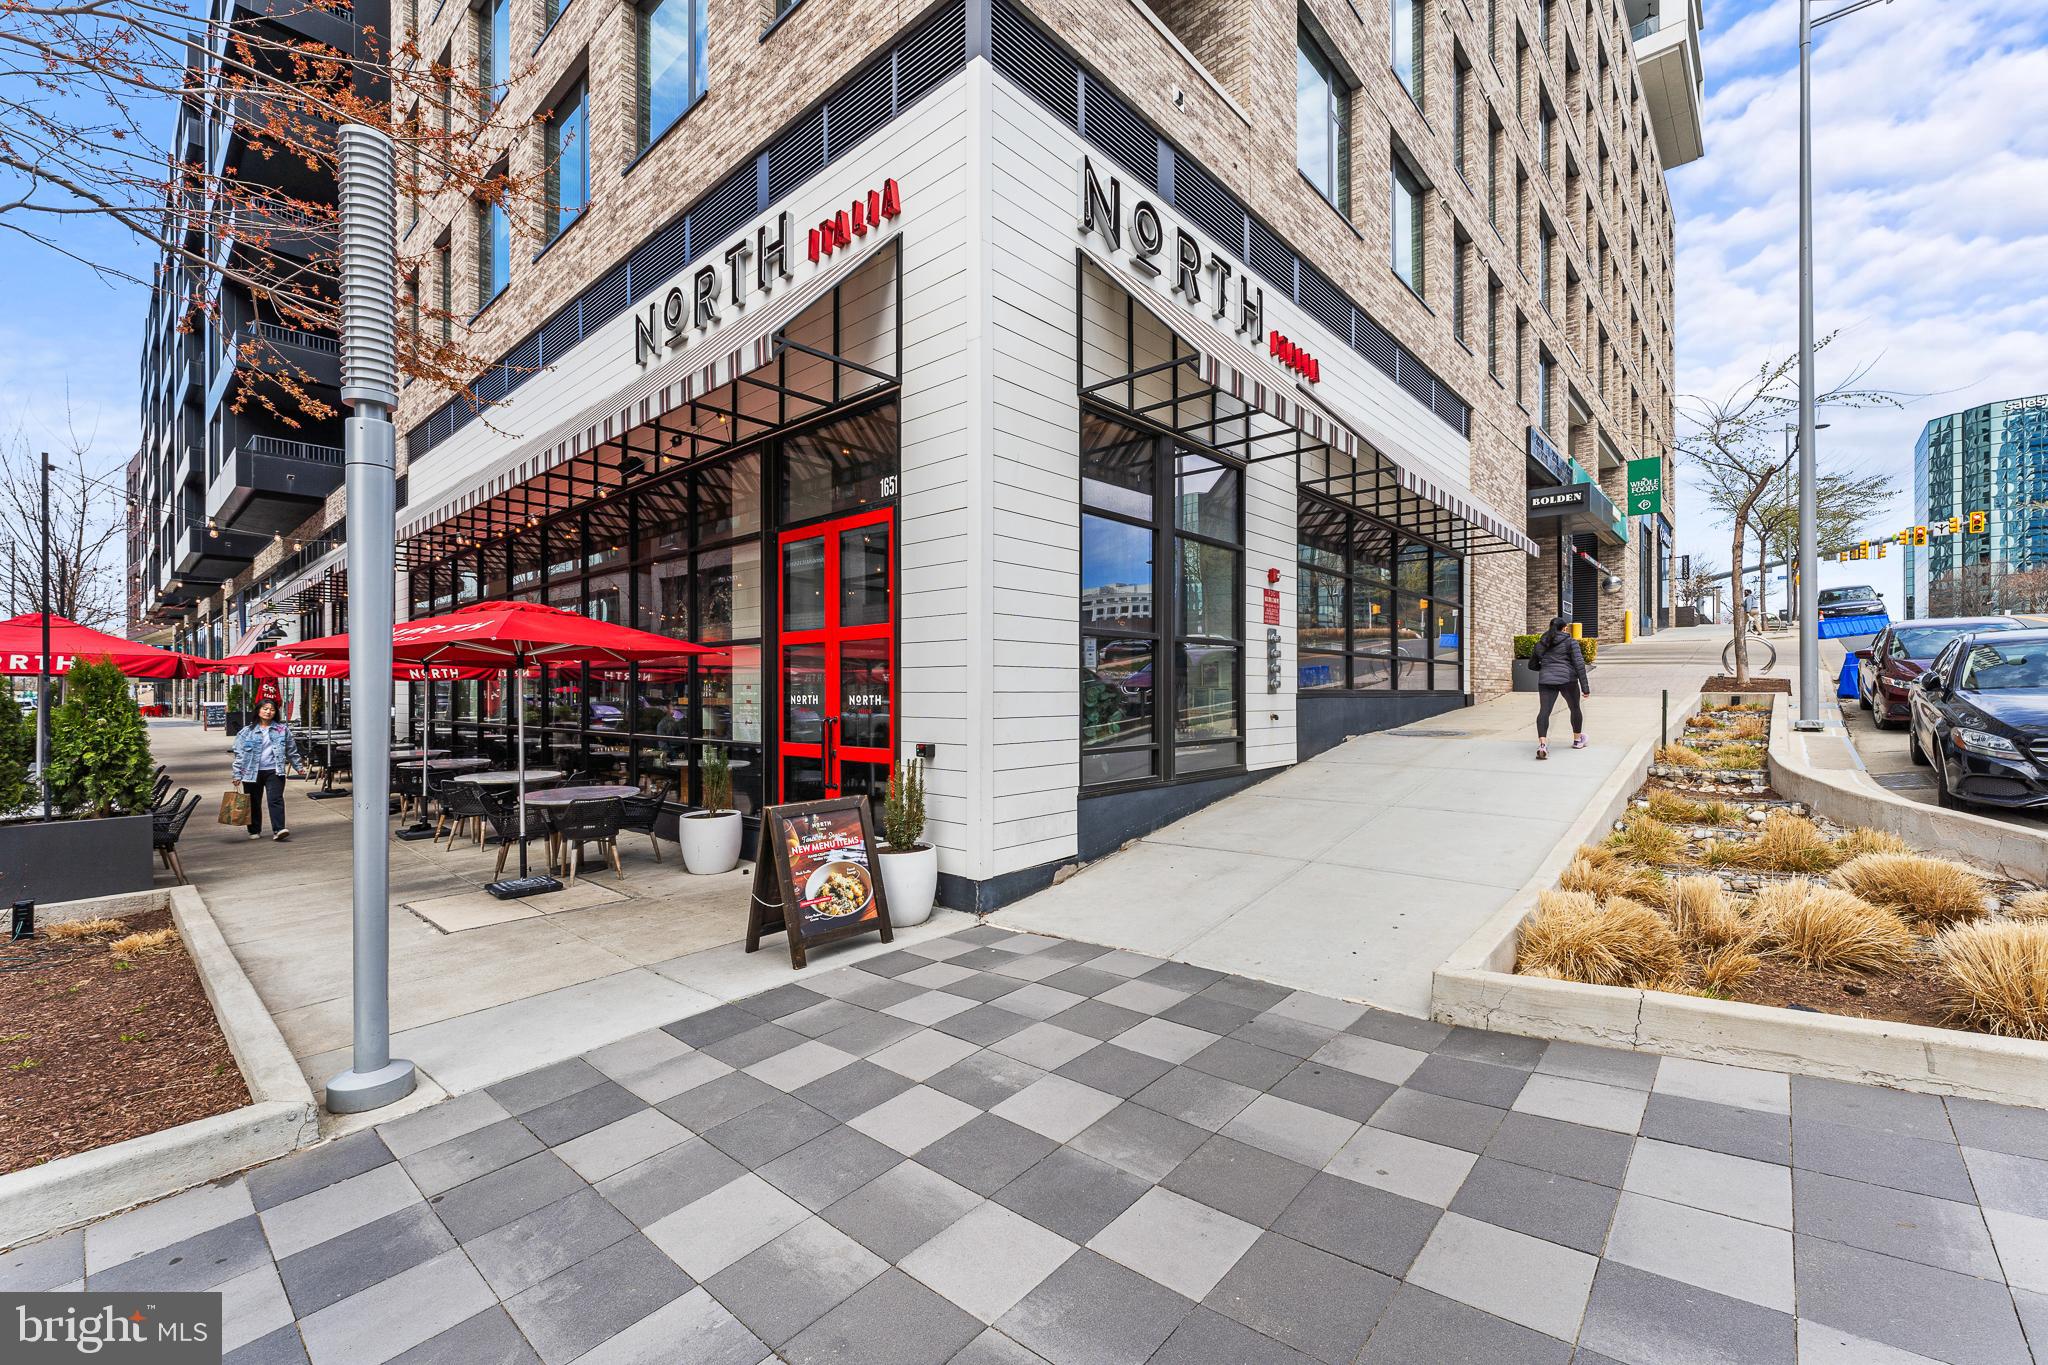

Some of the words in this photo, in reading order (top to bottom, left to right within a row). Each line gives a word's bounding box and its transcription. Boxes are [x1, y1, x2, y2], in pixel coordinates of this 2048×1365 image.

[1077, 155, 1264, 345] NORTH
[635, 210, 794, 366] NORTH
[808, 177, 901, 264] ITALIA
[879, 474, 898, 498] 1651
[1630, 478, 1659, 489] WHOLE
[1631, 485, 1659, 494] FOODS
[1532, 492, 1582, 507] BOLDEN
[287, 664, 328, 676] NORTH
[790, 694, 819, 705] NORTH
[848, 694, 882, 706] NORTH
[791, 845, 811, 855] NEW
[811, 839, 835, 851] MENU
[835, 836, 859, 848] ITEMS
